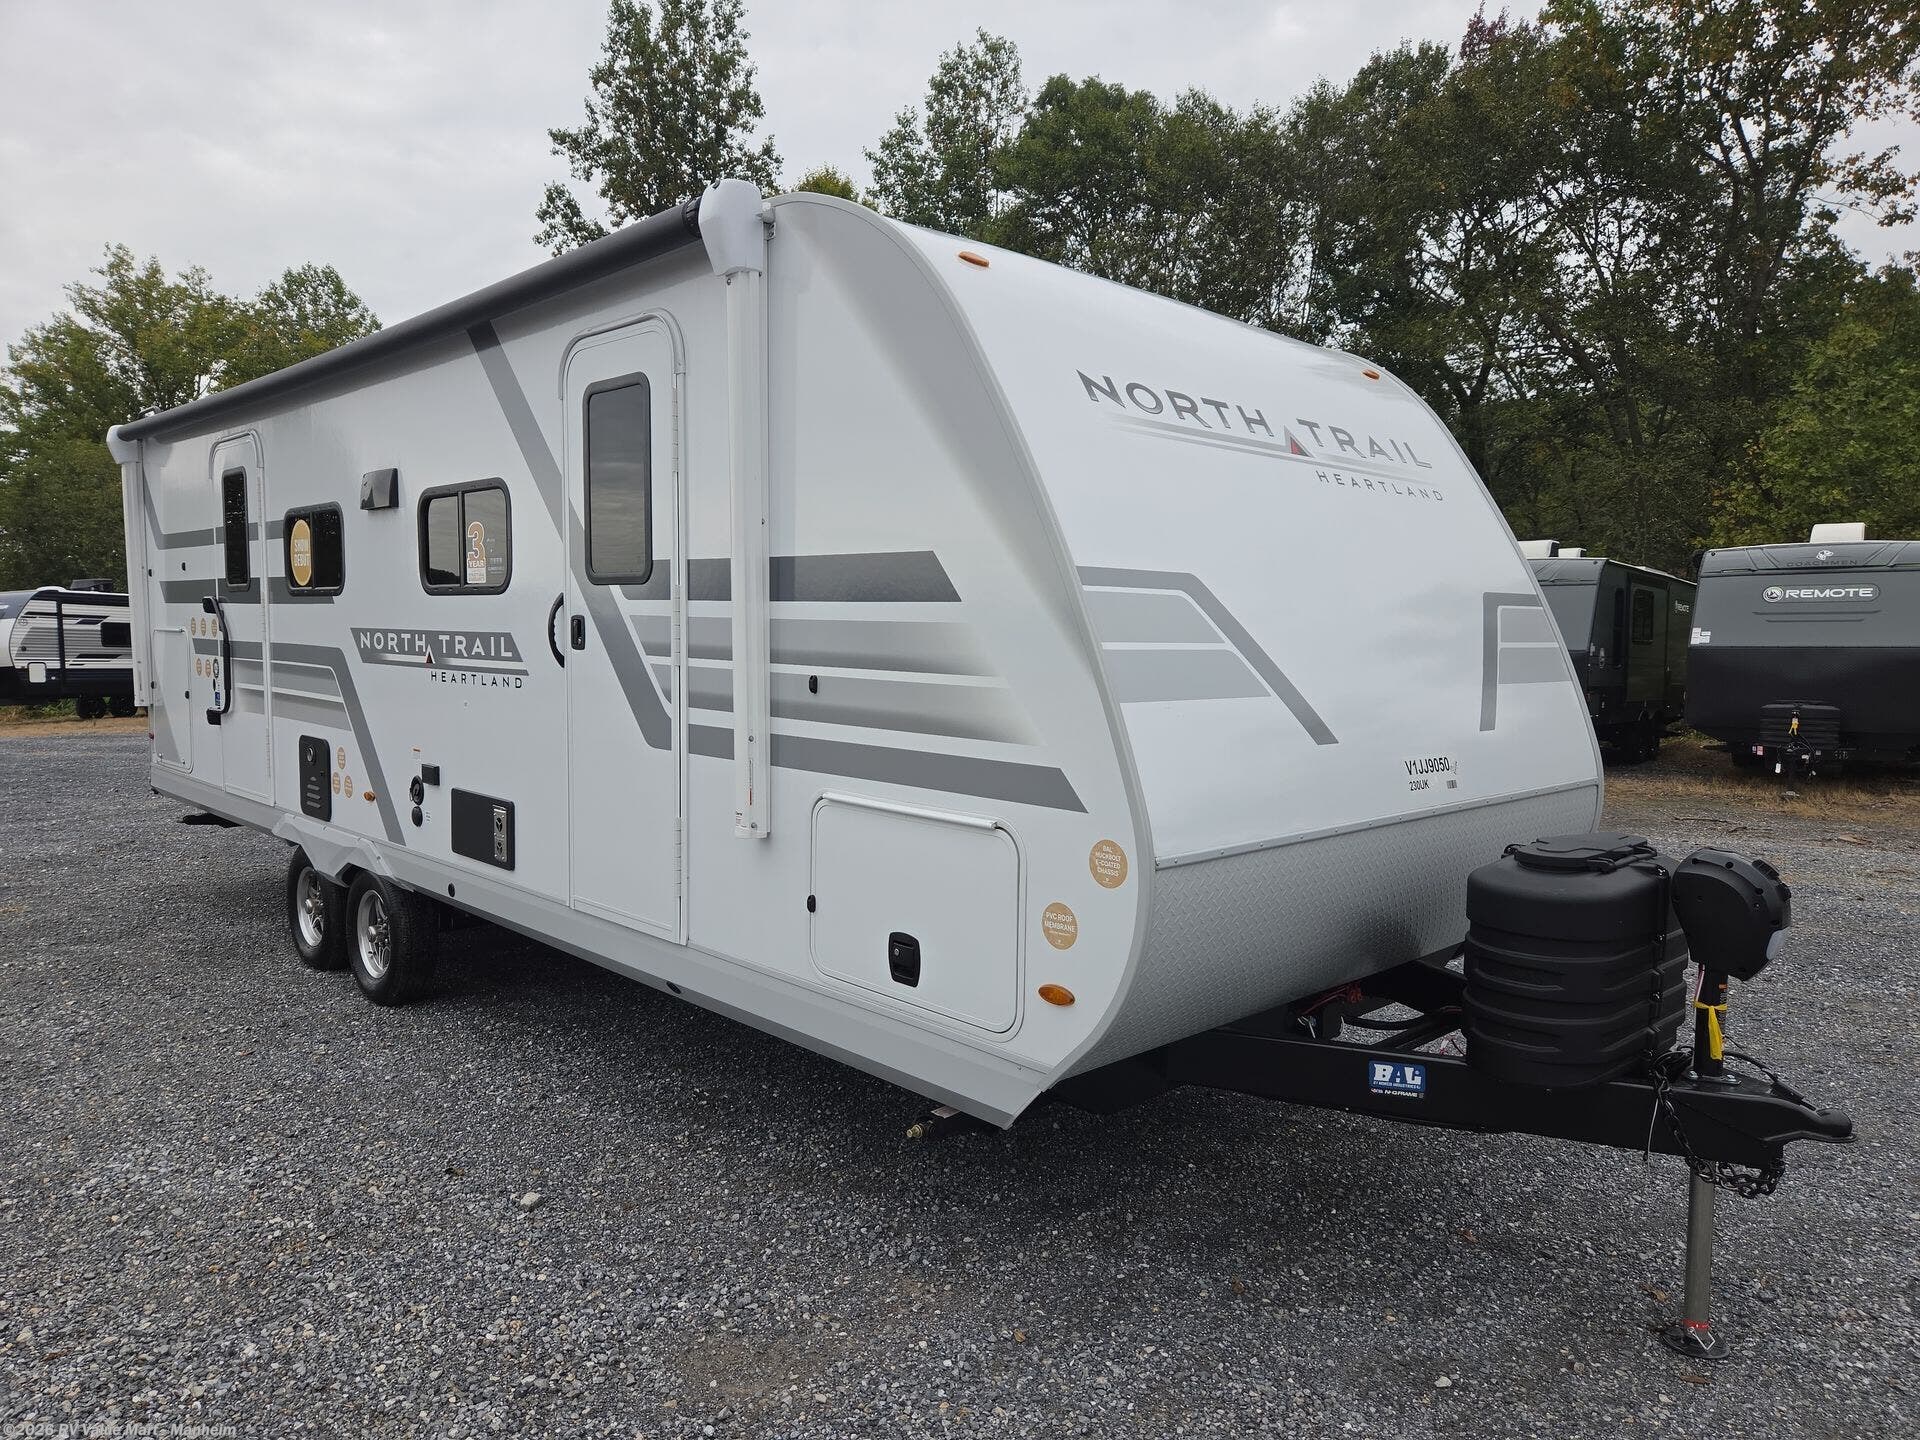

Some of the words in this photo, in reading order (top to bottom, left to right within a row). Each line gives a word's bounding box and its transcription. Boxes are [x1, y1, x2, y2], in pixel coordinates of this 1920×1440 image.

[1075, 368, 1275, 438] NORTH
[1296, 417, 1433, 469] TRAIL
[1315, 470, 1444, 501] HEARTLAND
[468, 521, 485, 560] 3
[1786, 559, 1858, 568] COACHMEN
[1785, 587, 1874, 599] REMOTE
[360, 631, 426, 653] NORTH
[438, 634, 513, 658] TRAIL
[431, 671, 523, 689] HEARTLAND
[1046, 911, 1058, 920] PVC
[1057, 913, 1073, 922] ROOF
